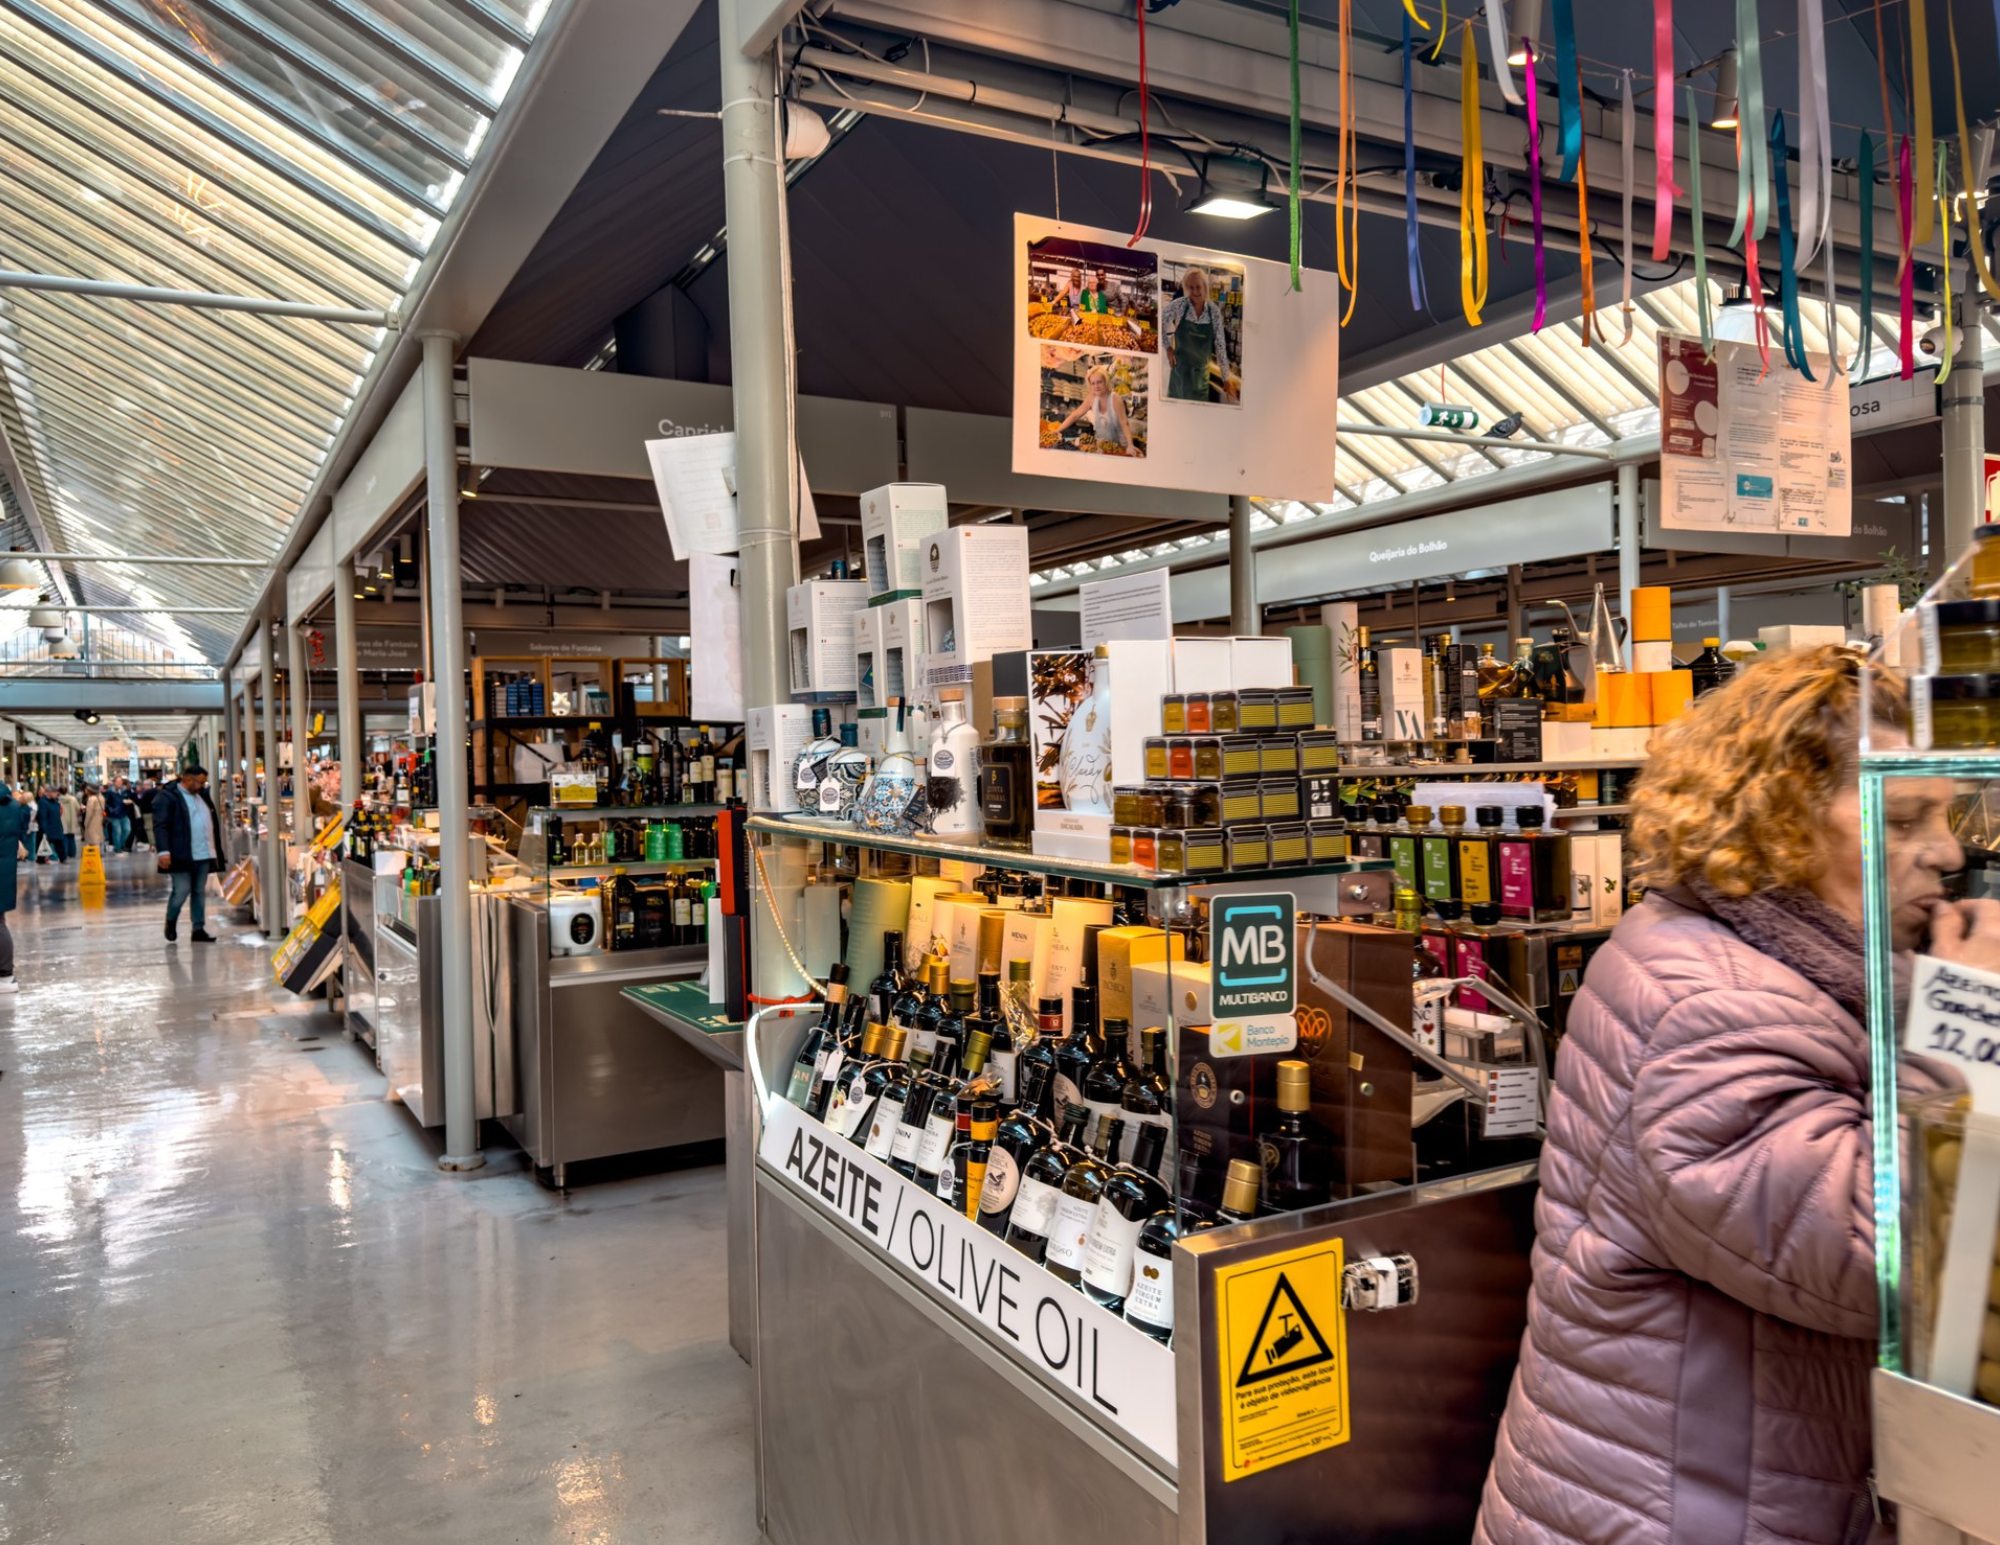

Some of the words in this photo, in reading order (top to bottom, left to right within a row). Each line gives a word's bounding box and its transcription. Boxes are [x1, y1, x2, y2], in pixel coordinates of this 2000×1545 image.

[1863, 524, 1888, 537] Bolhão
[1368, 547, 1405, 563] Queijaria
[1406, 545, 1418, 556] do
[1418, 539, 1448, 554] Bolhão
[384, 640, 418, 648] Fantasia
[529, 642, 559, 651] Sabores
[560, 643, 570, 651] de
[571, 643, 602, 652] Fantasia
[363, 649, 387, 657] Maria
[388, 649, 408, 658] José
[1221, 925, 1286, 968] MB
[1219, 991, 1289, 1007] MULTIBANCO
[1247, 1025, 1276, 1036] Banco
[1247, 1034, 1290, 1049] Montepio
[786, 1126, 882, 1236] AZEITE
[909, 1209, 1020, 1342] OLIVE
[1035, 1295, 1118, 1415] OIL
[1235, 1390, 1253, 1400] Para
[1253, 1386, 1267, 1394] sua
[1302, 1370, 1317, 1380] este
[1318, 1364, 1336, 1375] local
[1270, 1392, 1279, 1401] de
